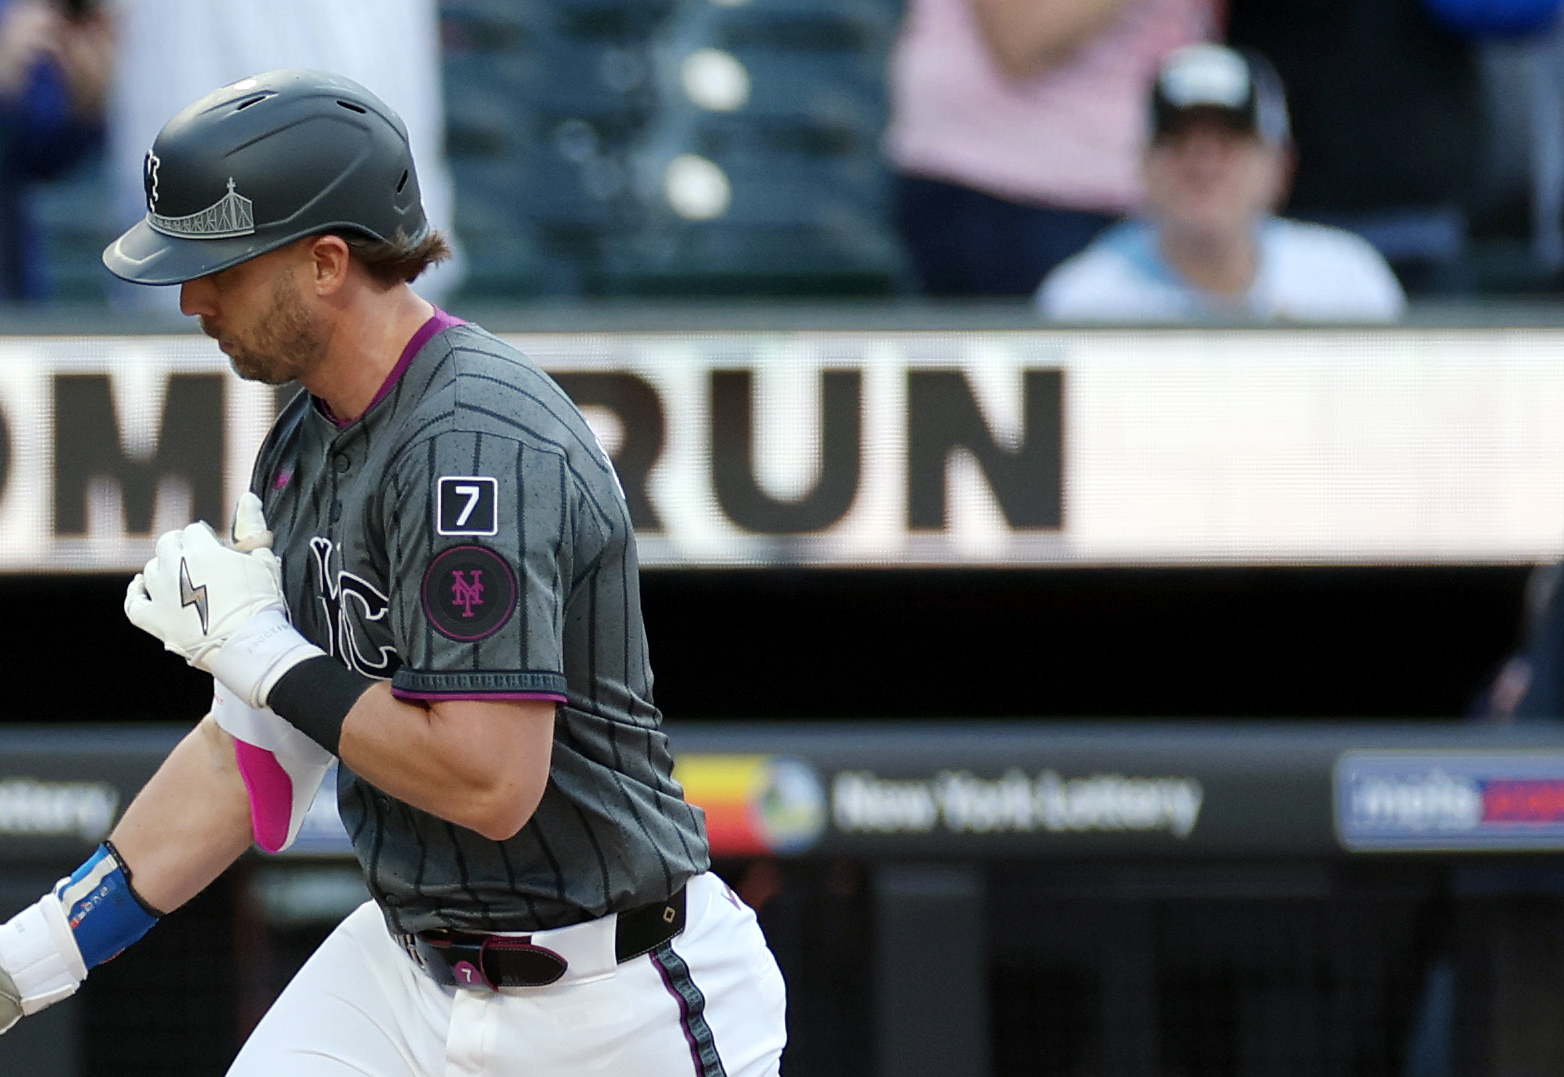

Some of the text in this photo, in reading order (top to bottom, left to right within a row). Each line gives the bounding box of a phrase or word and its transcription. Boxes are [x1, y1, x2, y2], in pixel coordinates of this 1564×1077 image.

[455, 486, 480, 526] 7
[832, 769, 935, 832] New
[937, 768, 1037, 832] York
[461, 968, 472, 983] 7
